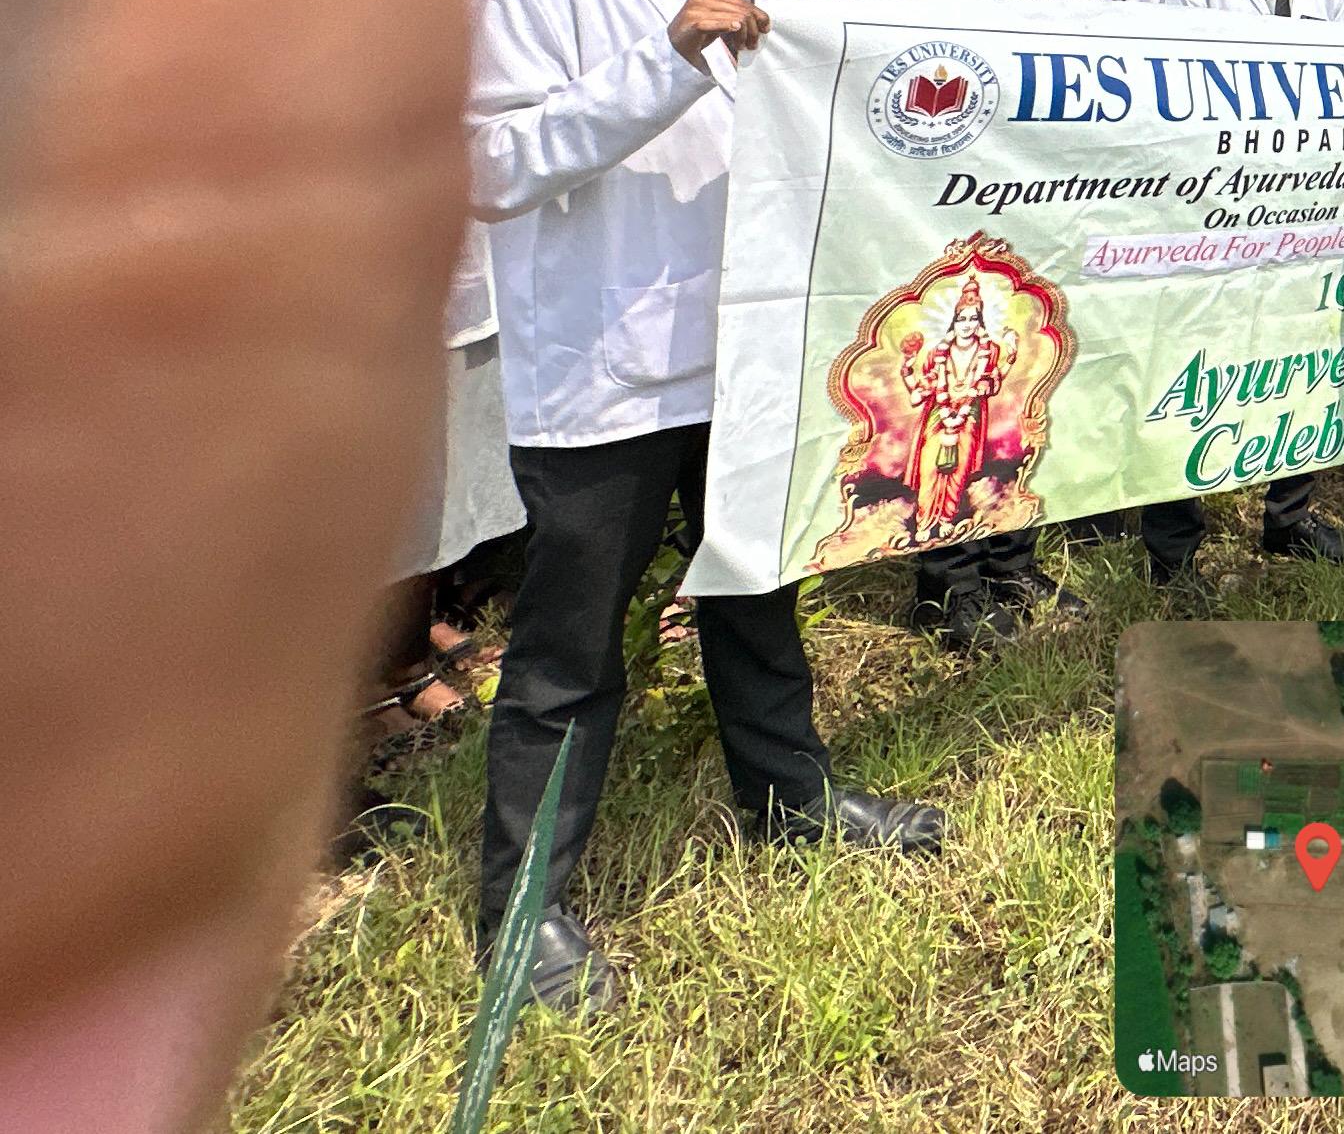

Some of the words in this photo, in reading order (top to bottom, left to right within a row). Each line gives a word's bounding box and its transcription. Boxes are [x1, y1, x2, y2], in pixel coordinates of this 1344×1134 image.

[880, 57, 908, 84] IES
[908, 43, 999, 87] UNIVERSITY
[1007, 50, 1134, 123] IES
[934, 171, 1171, 215] Department
[1175, 164, 1215, 204] of
[1204, 207, 1241, 229] On
[1246, 200, 1340, 226] Occasion
[1086, 237, 1218, 274] Ayurveda
[1223, 235, 1271, 262] For
